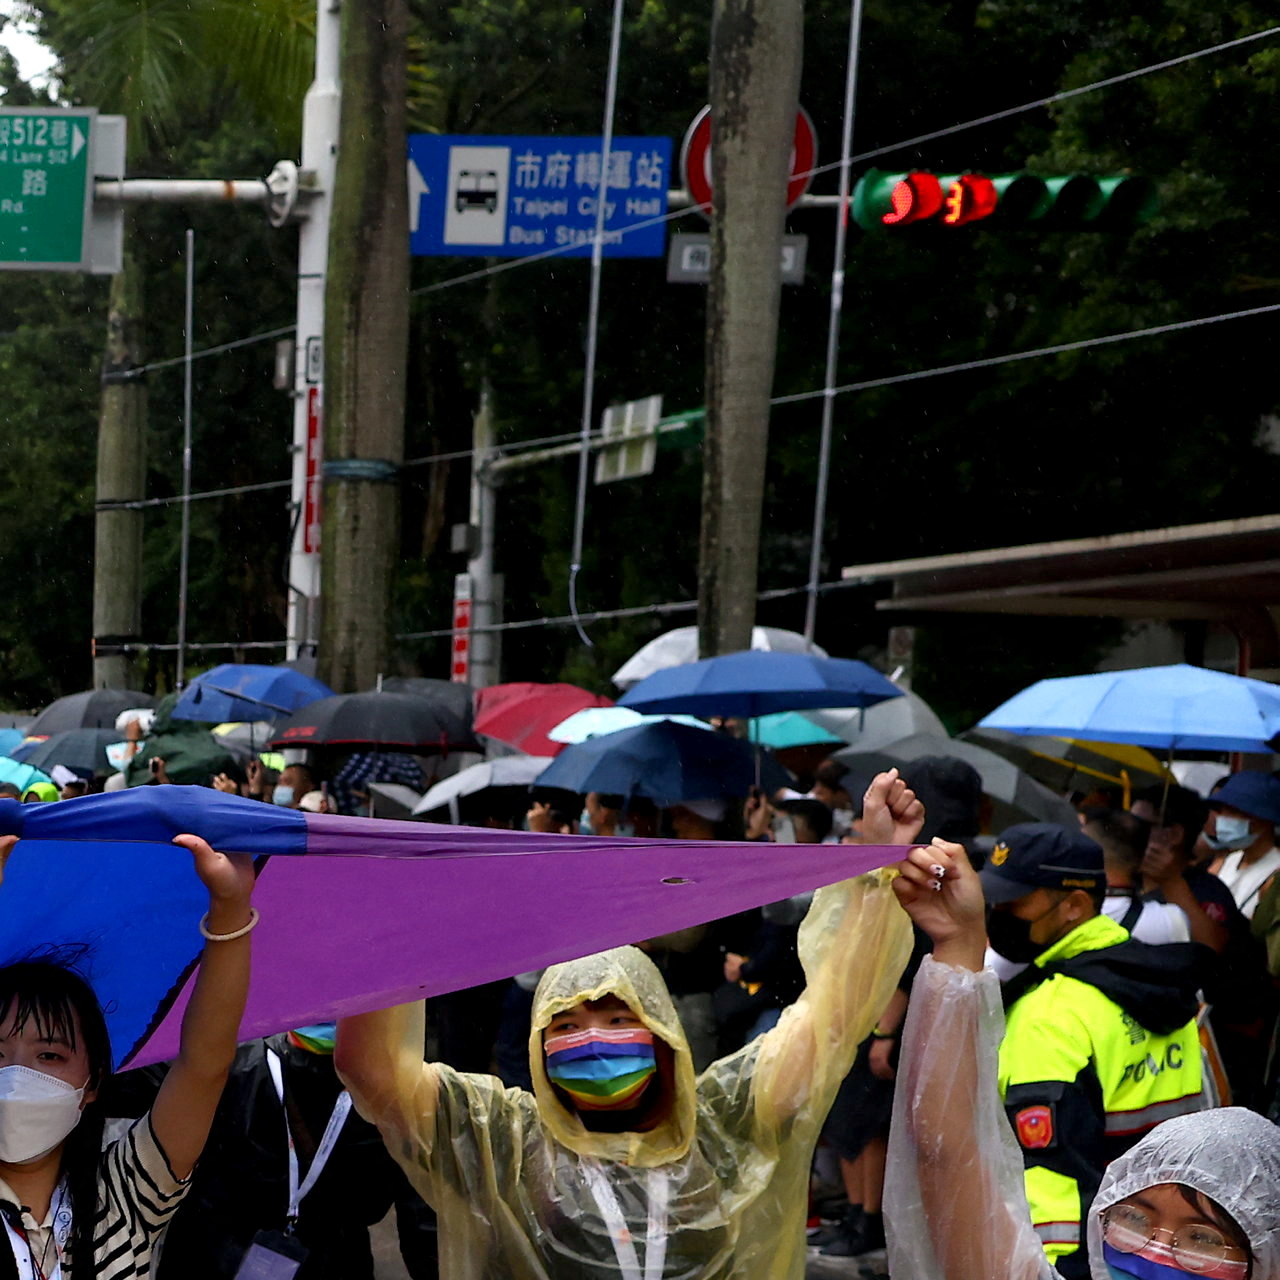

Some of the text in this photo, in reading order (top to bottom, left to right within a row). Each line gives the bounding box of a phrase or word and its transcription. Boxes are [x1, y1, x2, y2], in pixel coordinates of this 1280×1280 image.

[12, 149, 43, 163] Lane
[1, 200, 25, 214] Rd
[513, 197, 569, 219] Taipei
[626, 197, 661, 216] Hall
[509, 225, 545, 245] Bus
